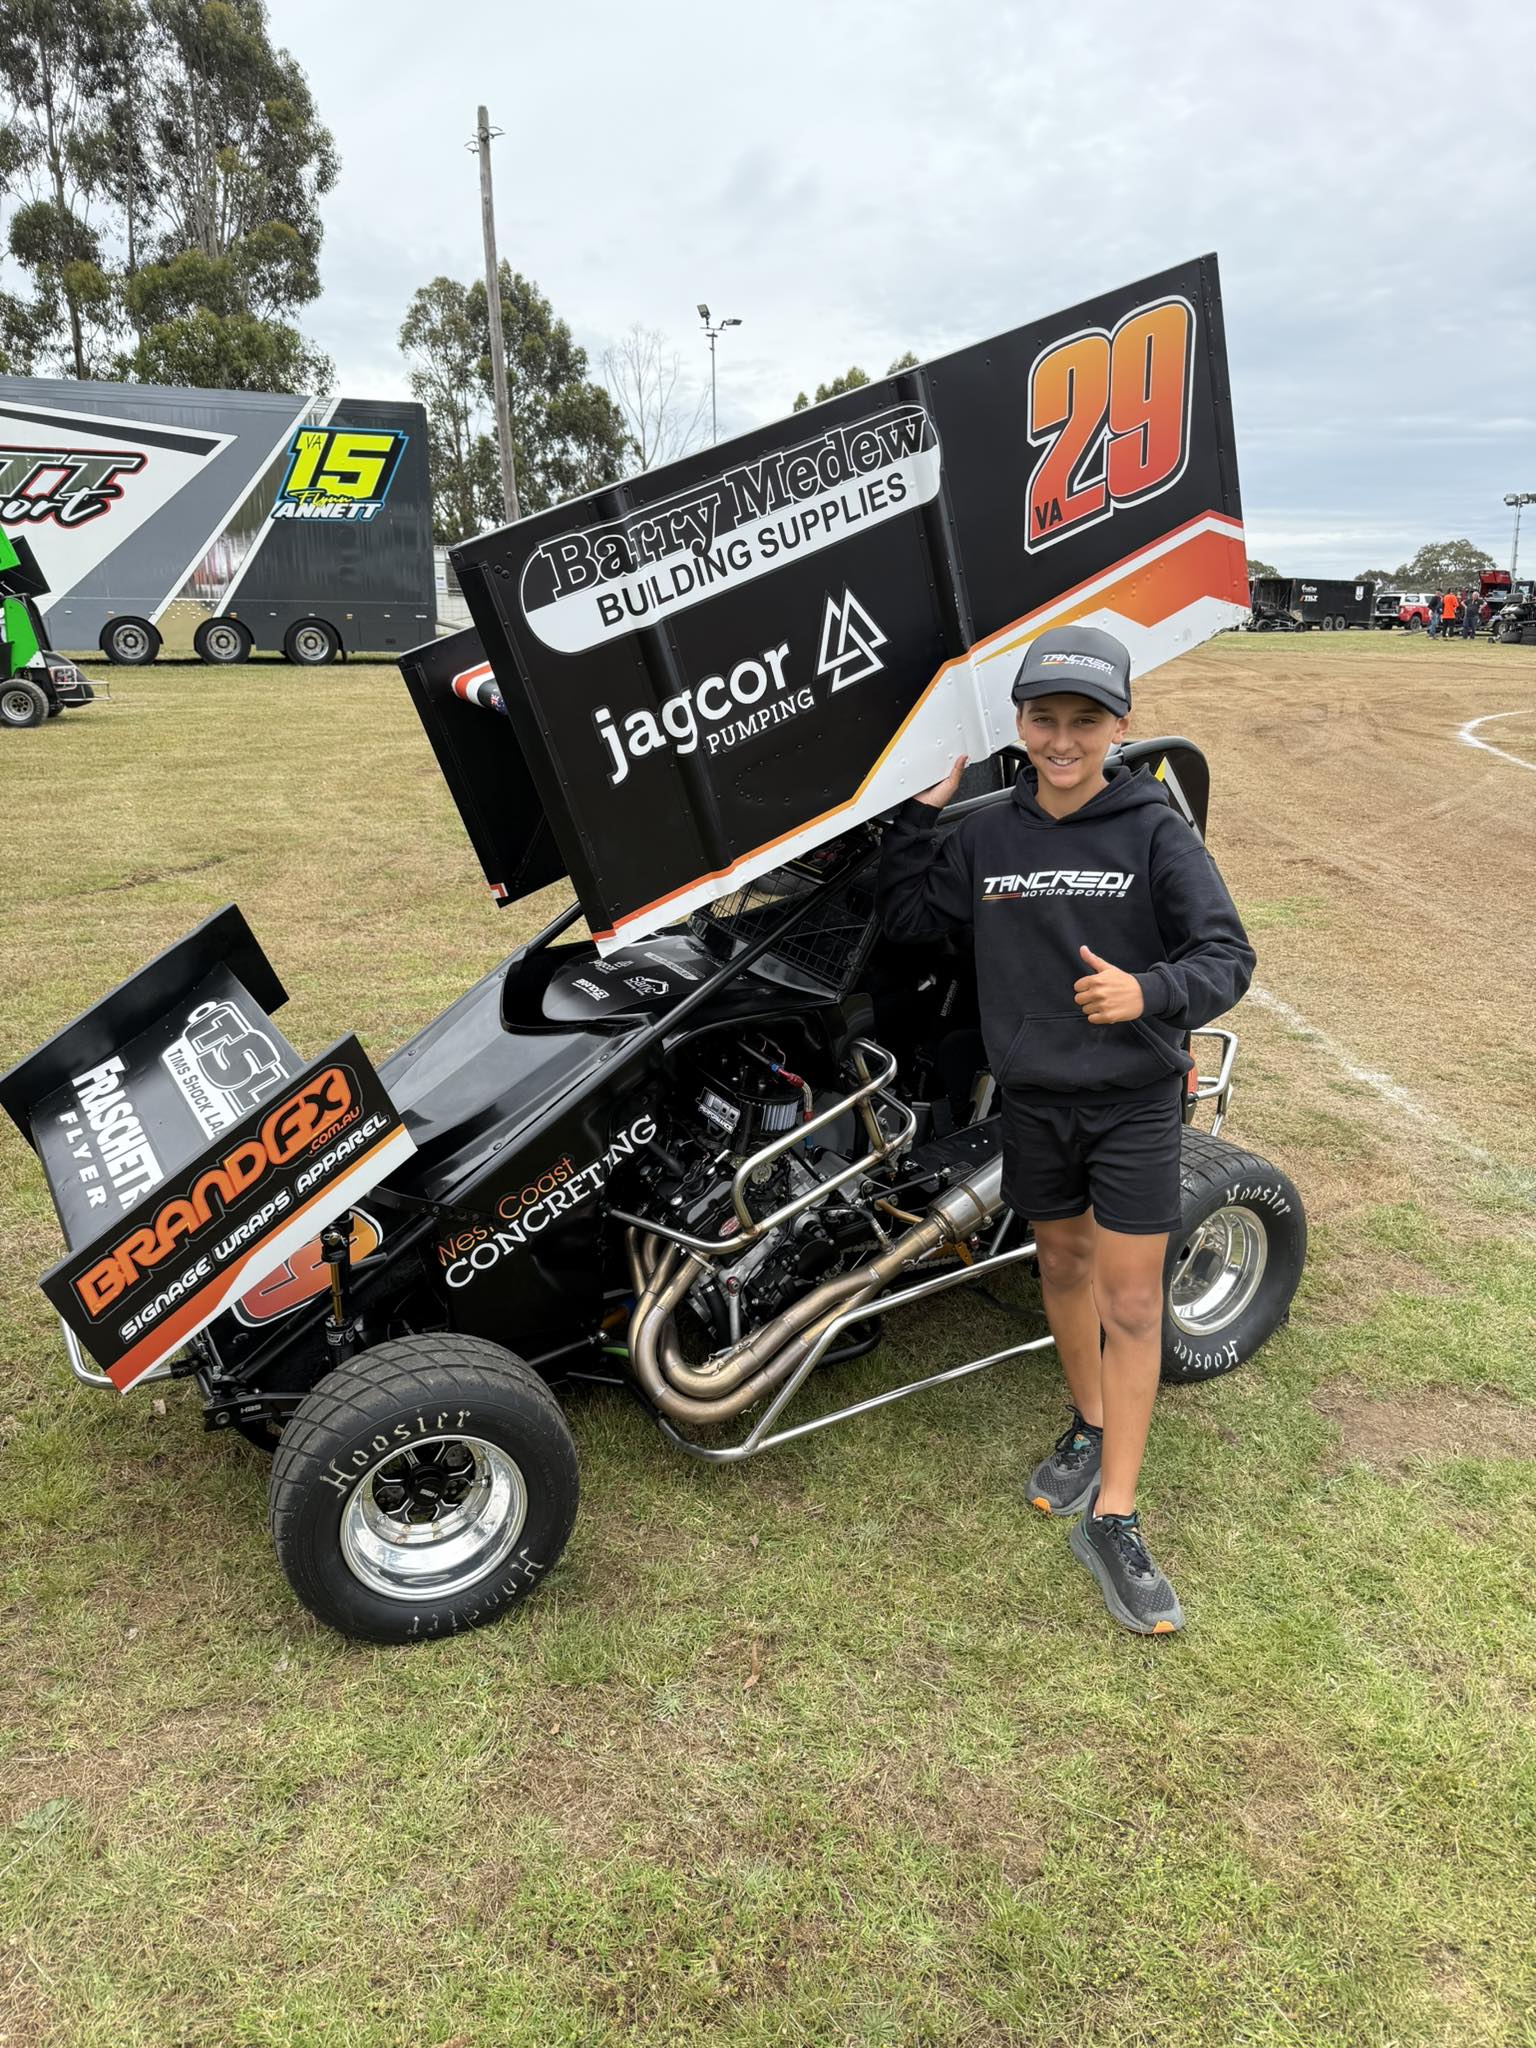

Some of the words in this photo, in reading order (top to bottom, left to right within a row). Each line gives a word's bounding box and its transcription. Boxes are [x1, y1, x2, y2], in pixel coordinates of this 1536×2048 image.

[305, 434, 322, 450] VA
[1028, 296, 1193, 552] 29
[286, 431, 395, 499] 15
[0, 487, 116, 521] ort
[273, 502, 382, 518] ANNETT
[539, 492, 722, 602] Barry
[723, 411, 926, 528] Medew
[1034, 498, 1064, 531] VA
[596, 539, 752, 628] BUILDING
[757, 472, 907, 558] SUPPLIES
[1041, 653, 1115, 672] TANCREDI
[595, 642, 790, 785] jagcor
[706, 687, 815, 755] PUMPING
[983, 870, 1135, 894] TANCREDI
[1020, 888, 1127, 898] MOTORSPORTS
[167, 1047, 191, 1076] TIMS
[182, 1074, 214, 1112] SHOCK
[59, 1110, 107, 1209] FLYER
[498, 1156, 575, 1219] Coast
[120, 1256, 211, 1341] SIGNAGE
[214, 1190, 291, 1262] WRAPS
[297, 1114, 388, 1193] APPAREL
[319, 1408, 472, 1498] Hoosier
